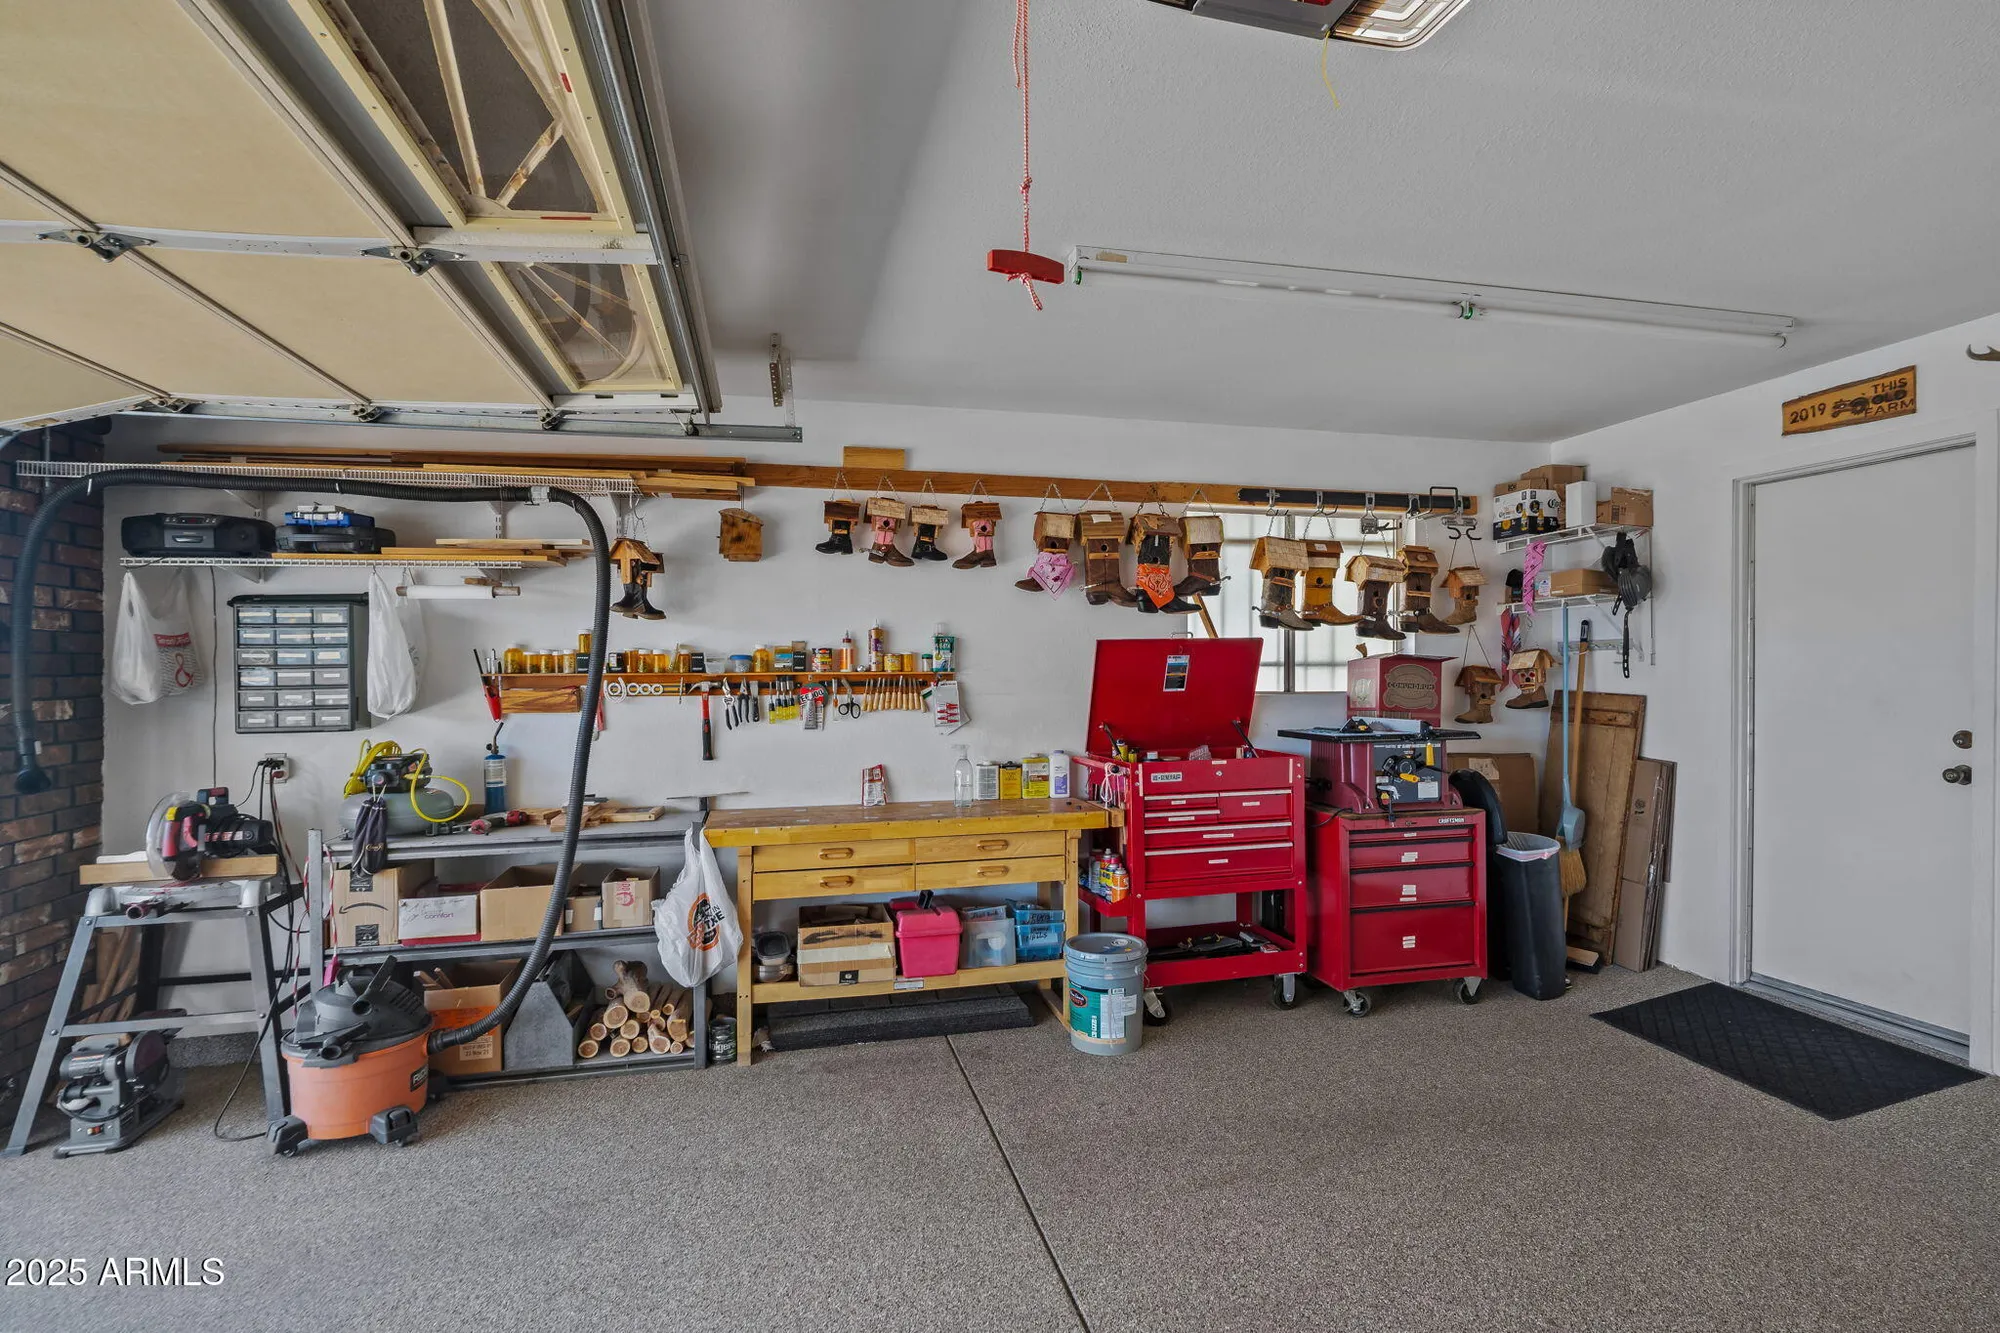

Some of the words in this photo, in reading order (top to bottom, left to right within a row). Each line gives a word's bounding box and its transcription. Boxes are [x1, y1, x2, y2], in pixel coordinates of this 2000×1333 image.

[1871, 377, 1908, 394] THIS
[1789, 403, 1827, 425] 2019
[1864, 399, 1915, 418] FARM
[424, 912, 454, 920] comfort
